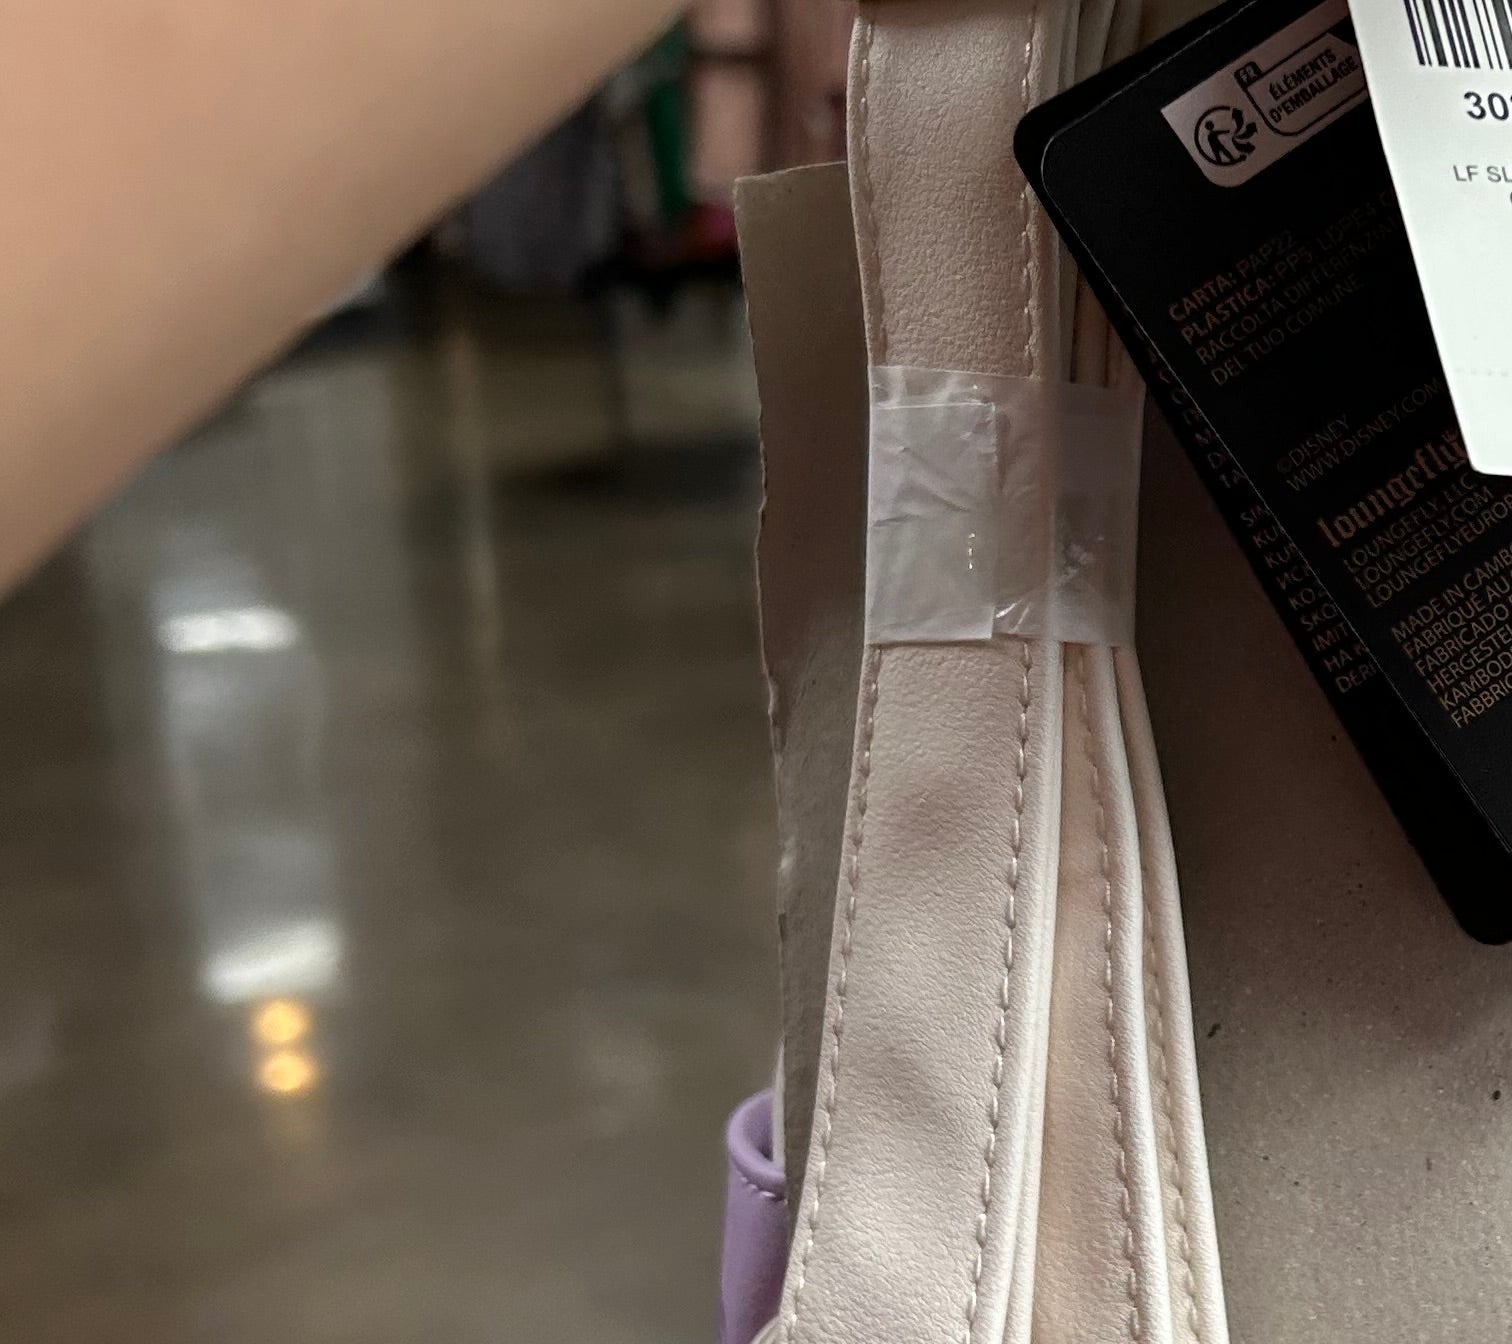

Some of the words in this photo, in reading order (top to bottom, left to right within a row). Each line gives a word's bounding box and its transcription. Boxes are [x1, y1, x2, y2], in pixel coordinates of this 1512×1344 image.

[1266, 44, 1337, 101] ÉLÉMENTS
[1269, 54, 1358, 124] D'EMBALLAGE
[1453, 164, 1479, 182] LF
[1167, 267, 1236, 324] CARTA:
[1180, 269, 1276, 345] PLASTICA:
[1195, 293, 1286, 365] RACCOLTA
[1210, 353, 1247, 386] DEL
[1244, 325, 1287, 363] TUO
[1316, 427, 1469, 552] loungefly
[1442, 472, 1477, 503] LLC
[1390, 597, 1444, 642] MADE
[1441, 583, 1464, 606] IN
[1482, 576, 1511, 602] AU
[1414, 602, 1511, 677] FABRICADO
